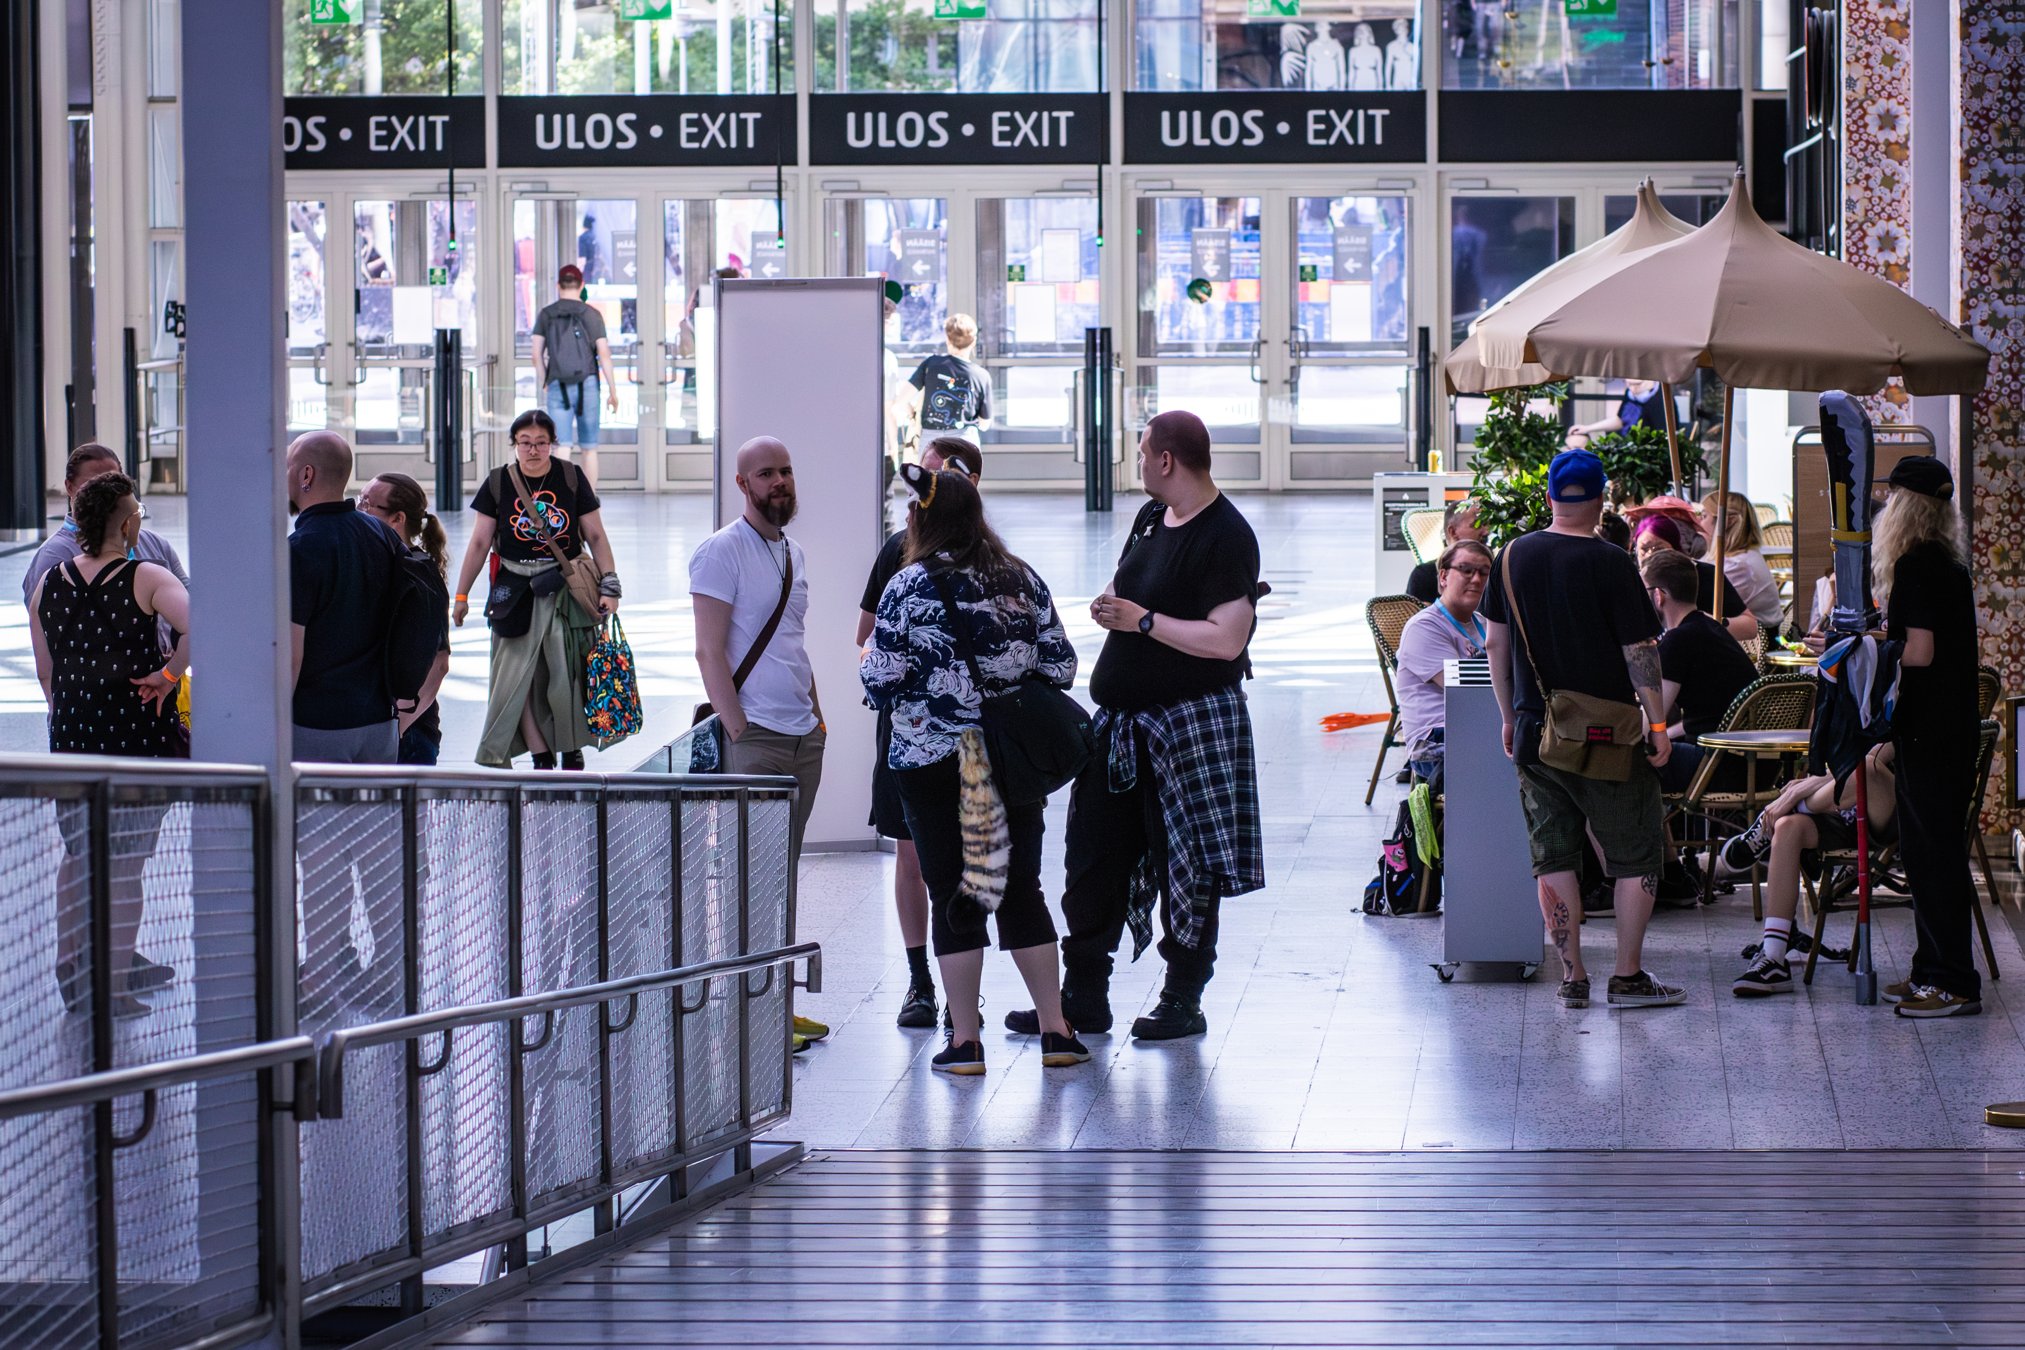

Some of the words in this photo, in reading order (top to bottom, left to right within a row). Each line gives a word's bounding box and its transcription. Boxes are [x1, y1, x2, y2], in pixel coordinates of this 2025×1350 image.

[369, 115, 450, 152] EXIT
[535, 113, 638, 150] ULOS
[679, 112, 762, 149] EXIT
[846, 111, 949, 148] ULOS
[991, 111, 1075, 147] EXIT
[1161, 109, 1264, 147] ULOS
[1307, 109, 1390, 146] EXIT
